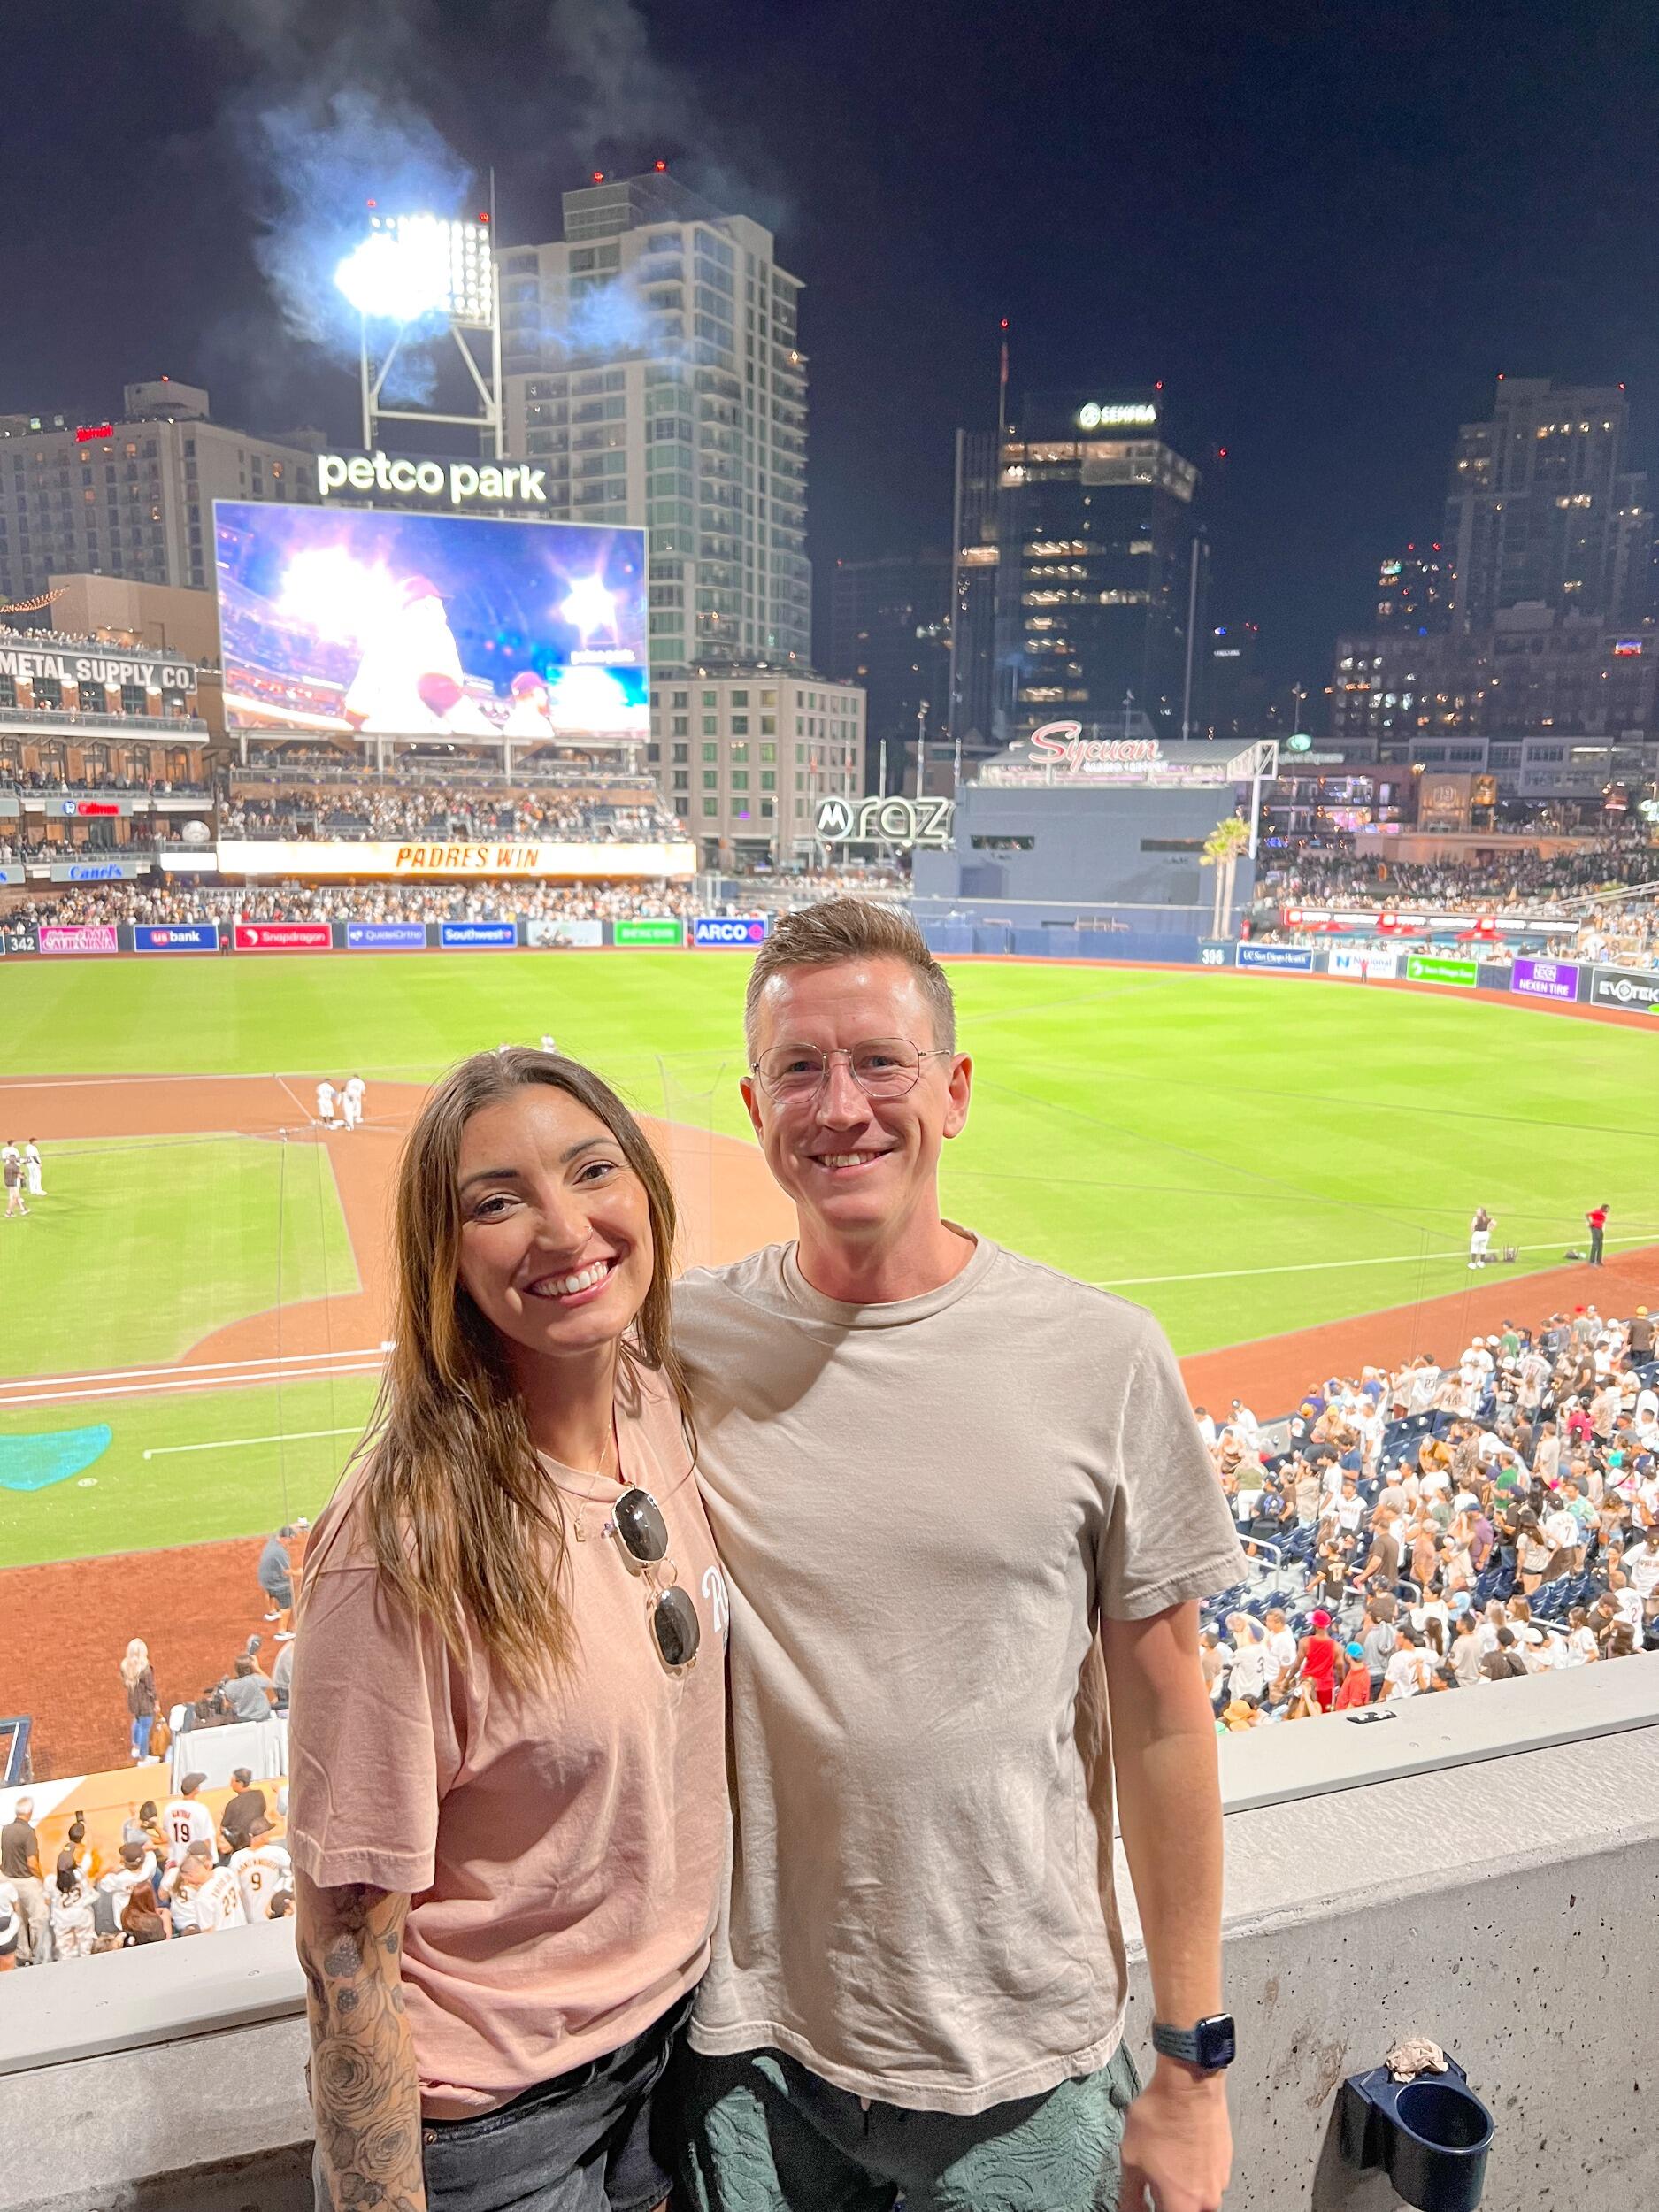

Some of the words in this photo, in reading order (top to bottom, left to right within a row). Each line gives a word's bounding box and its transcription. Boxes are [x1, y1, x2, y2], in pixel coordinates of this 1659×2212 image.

[317, 450, 445, 495] petco
[449, 464, 547, 504] park
[0, 651, 72, 680] METAL
[76, 658, 155, 687] SUPPLY
[162, 665, 196, 690] CO.
[1028, 719, 1164, 773] Sycuan
[396, 847, 488, 868] PADRES
[496, 848, 539, 868] WIN
[169, 930, 201, 943] bank
[262, 930, 326, 944] Snapdragon
[444, 927, 504, 941] Southwest
[696, 924, 748, 940] ARCO
[11, 936, 35, 951] 342
[42, 937, 115, 950] CALIFORNIA
[1519, 978, 1548, 993] NEXEN
[1548, 983, 1570, 996] TIRE
[1599, 979, 1659, 1002] EVOTEK
[173, 1822, 191, 1843] 19
[250, 1871, 262, 1892] 9
